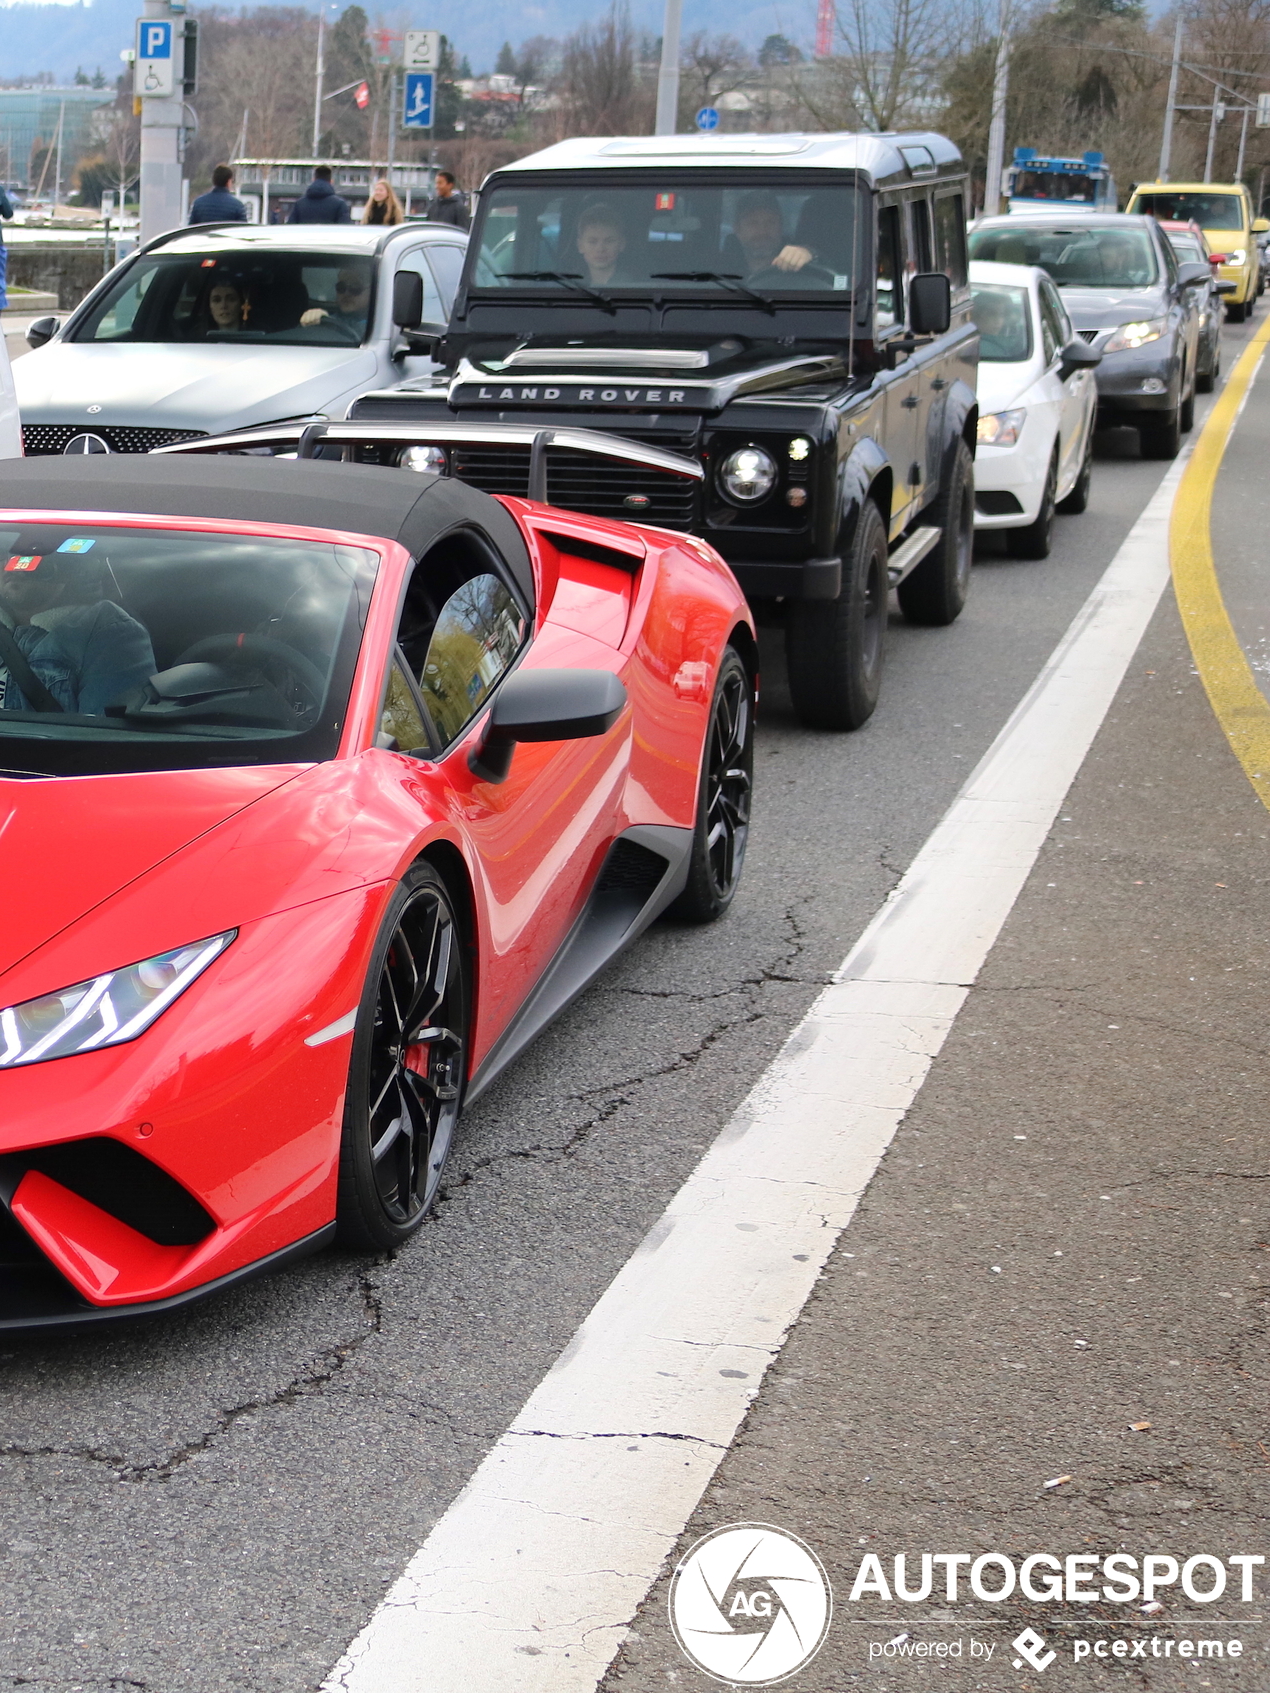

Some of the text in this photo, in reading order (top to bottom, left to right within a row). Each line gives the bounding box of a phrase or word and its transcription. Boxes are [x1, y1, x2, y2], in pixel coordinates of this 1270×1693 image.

[147, 27, 165, 56] P
[479, 387, 685, 402] LAND ROVER
